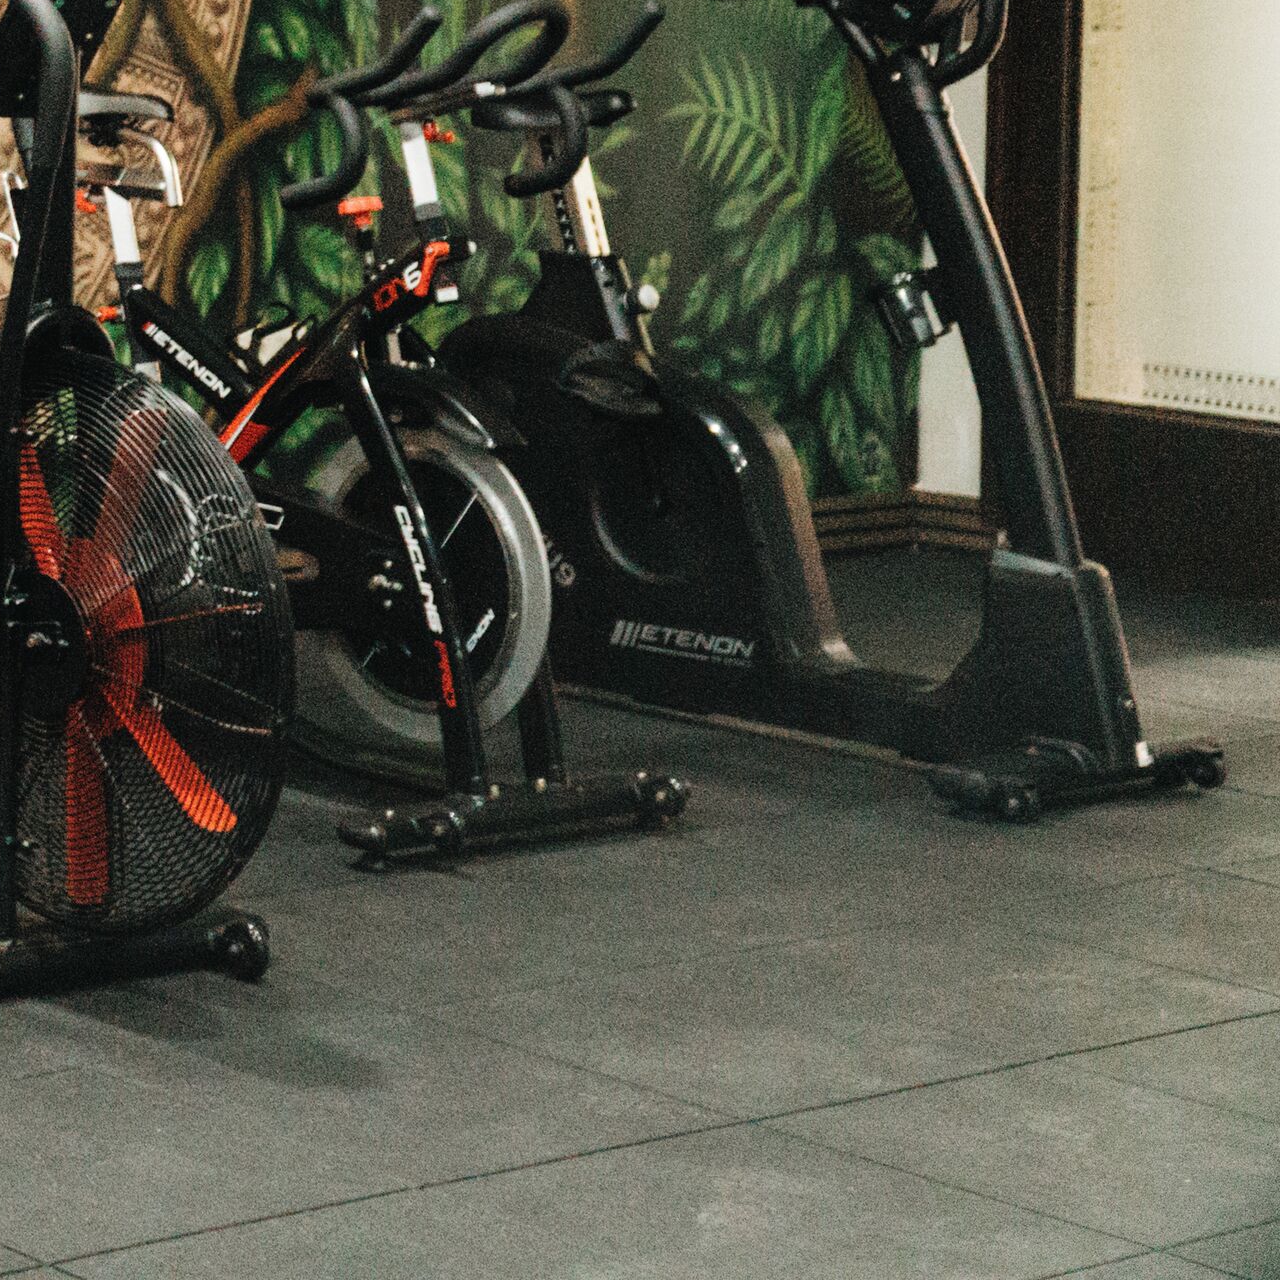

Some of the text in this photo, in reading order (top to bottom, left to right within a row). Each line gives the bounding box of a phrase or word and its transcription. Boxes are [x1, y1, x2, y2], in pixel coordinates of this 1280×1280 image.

[153, 329, 231, 399] ETENON
[393, 505, 443, 635] CYCLING
[640, 623, 756, 658] ETENON
